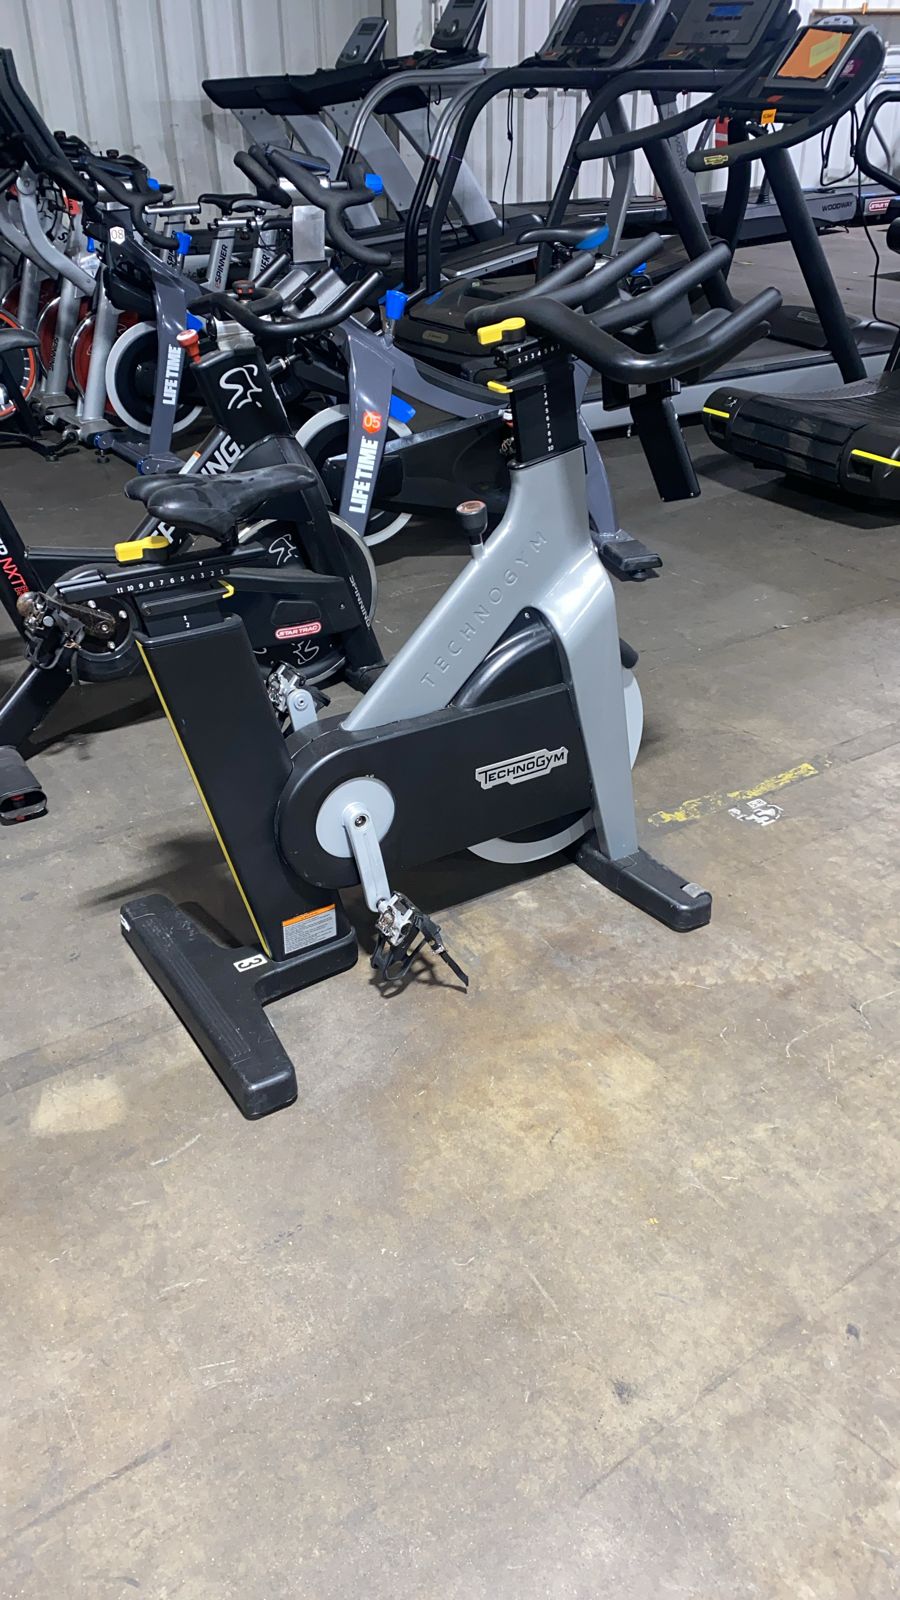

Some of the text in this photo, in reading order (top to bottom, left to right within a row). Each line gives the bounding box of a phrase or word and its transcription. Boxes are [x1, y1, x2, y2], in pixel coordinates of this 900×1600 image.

[821, 201, 853, 212] WOODWAY
[111, 229, 124, 240] 08
[162, 343, 182, 405] LIFE TIME
[363, 412, 381, 429] 05
[348, 437, 379, 514] LIFE TIME
[0, 557, 27, 587] NXT
[420, 530, 549, 689] TECHNOGYM
[279, 624, 318, 637] STAR TRAC
